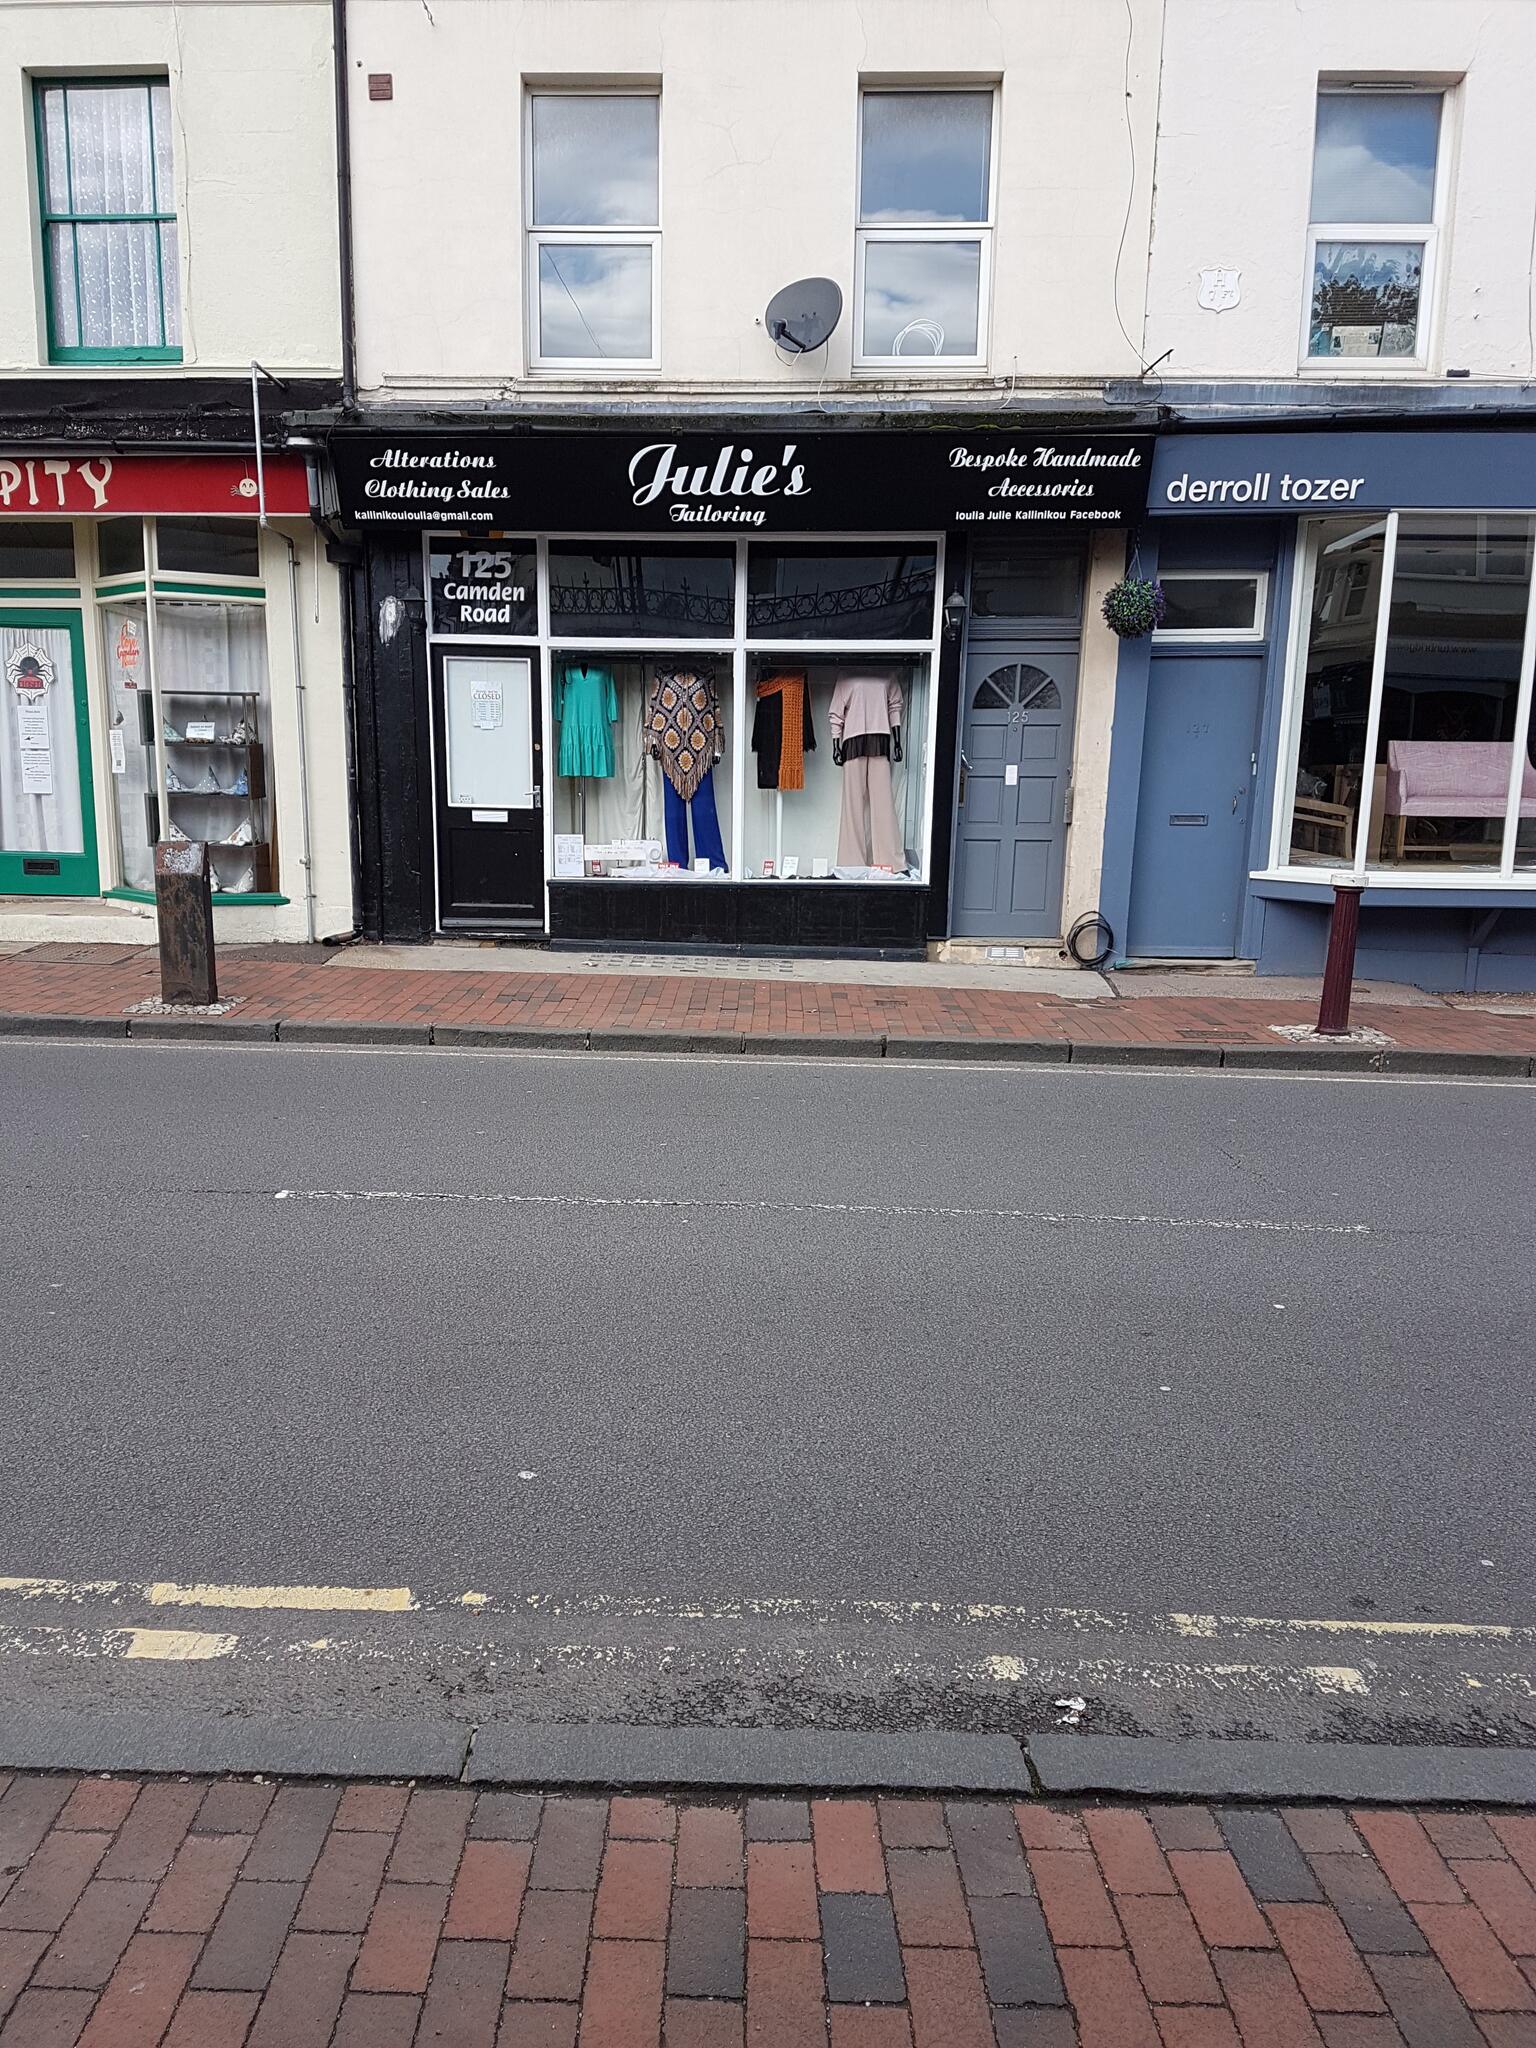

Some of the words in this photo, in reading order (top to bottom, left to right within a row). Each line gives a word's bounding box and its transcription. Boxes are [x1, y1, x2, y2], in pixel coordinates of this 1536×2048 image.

[370, 449, 497, 468] Alterations
[948, 447, 1028, 472] Bespoke
[1033, 447, 1143, 468] Handmade
[628, 443, 812, 507] Julie's
[364, 479, 455, 503] Clothing
[457, 479, 512, 499] Sales
[988, 478, 1095, 498] Accessories
[1166, 473, 1271, 502] derroll
[1280, 474, 1365, 501] tozer
[669, 503, 767, 526] Tailoring
[987, 510, 1012, 520] Julie
[1015, 510, 1067, 520] Kallinikou
[1070, 509, 1122, 520] Facebook
[456, 551, 512, 579] 125
[444, 582, 525, 602] Camden
[460, 604, 511, 624] Road
[1007, 711, 1030, 723] 125
